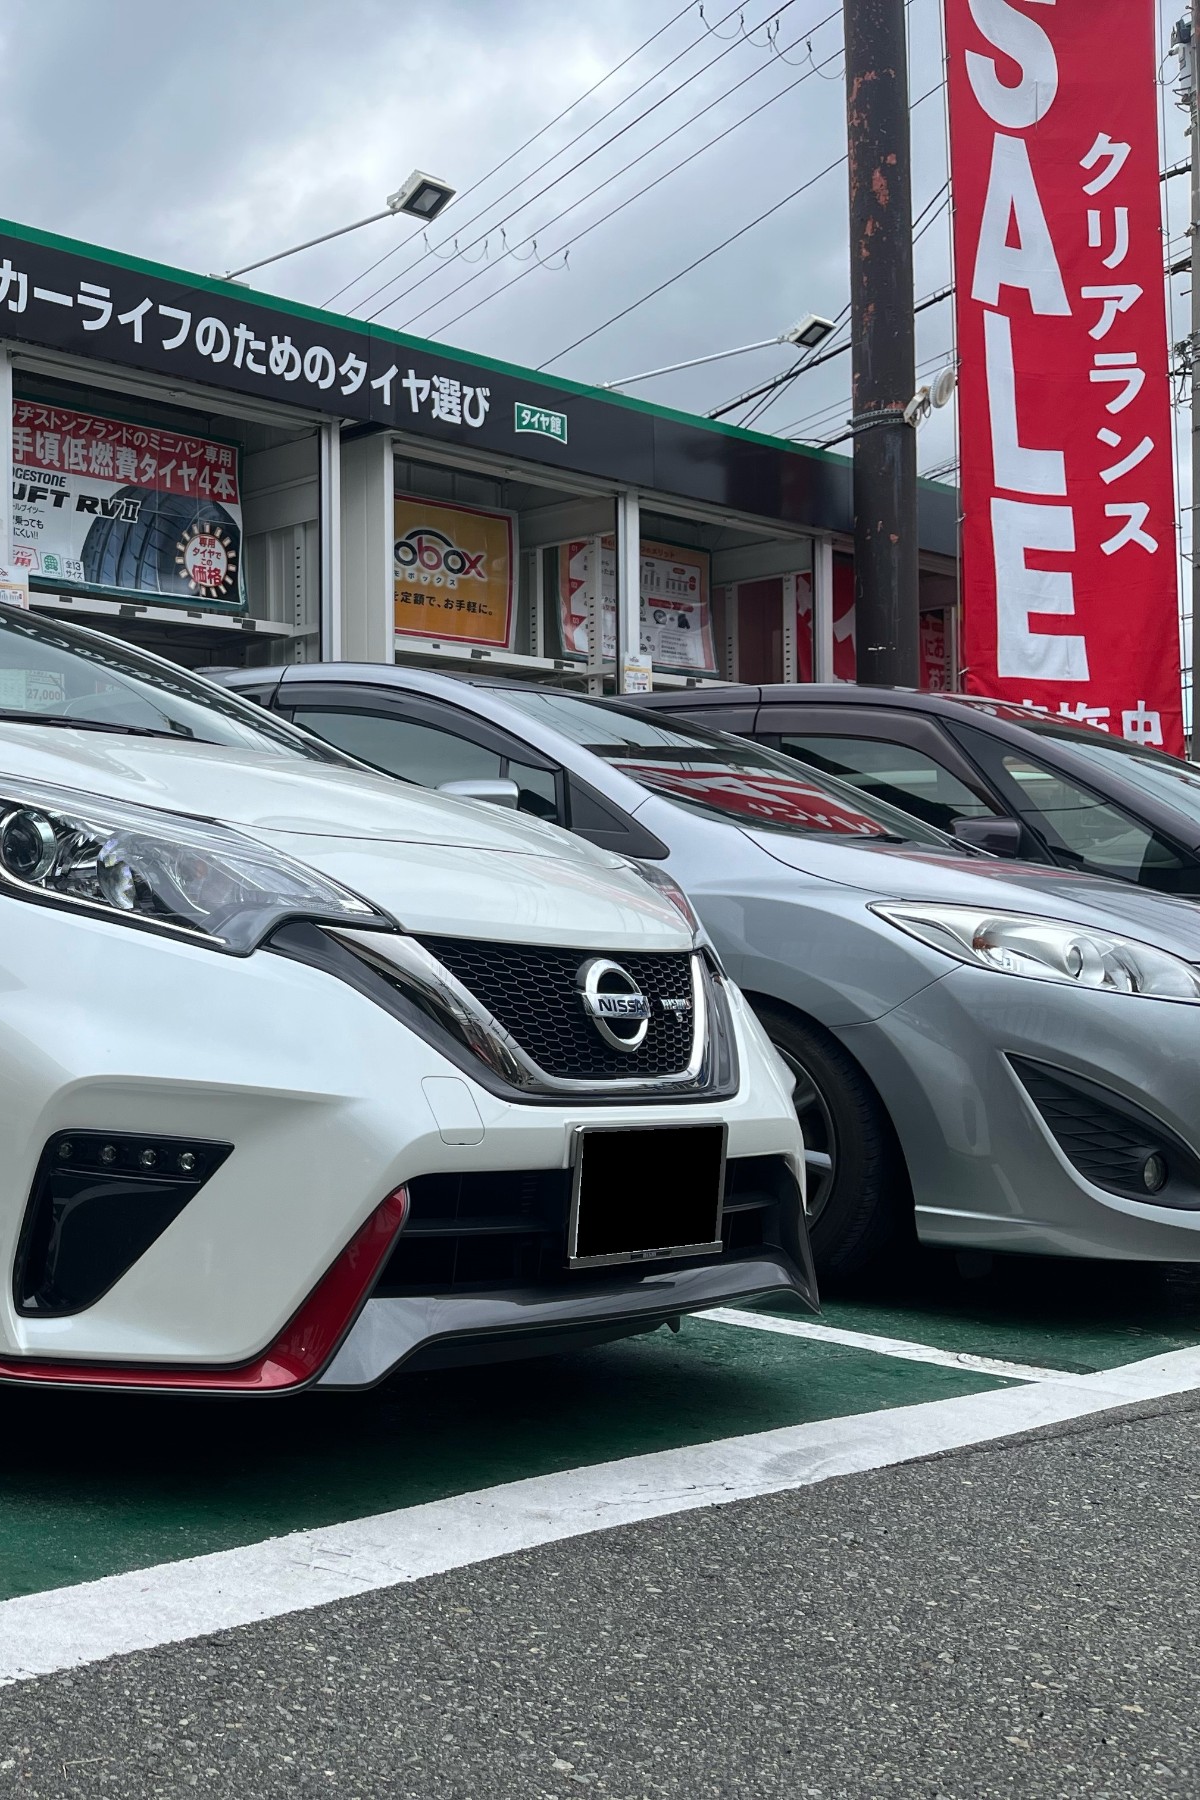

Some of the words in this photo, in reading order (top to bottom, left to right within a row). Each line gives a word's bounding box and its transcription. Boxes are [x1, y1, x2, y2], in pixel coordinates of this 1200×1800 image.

[965, 0, 1090, 682] SALE
[1079, 132, 1159, 556] クリアランス
[13, 427, 236, 500] 手頃低燃費タイヤ4本
[13, 516, 44, 529] 乗っても
[199, 536, 215, 548] 専用
[192, 548, 221, 559] タイヤで
[65, 561, 82, 571] 全13
[201, 558, 213, 566] この
[66, 570, 83, 580] サイズ
[191, 564, 222, 586] 価格
